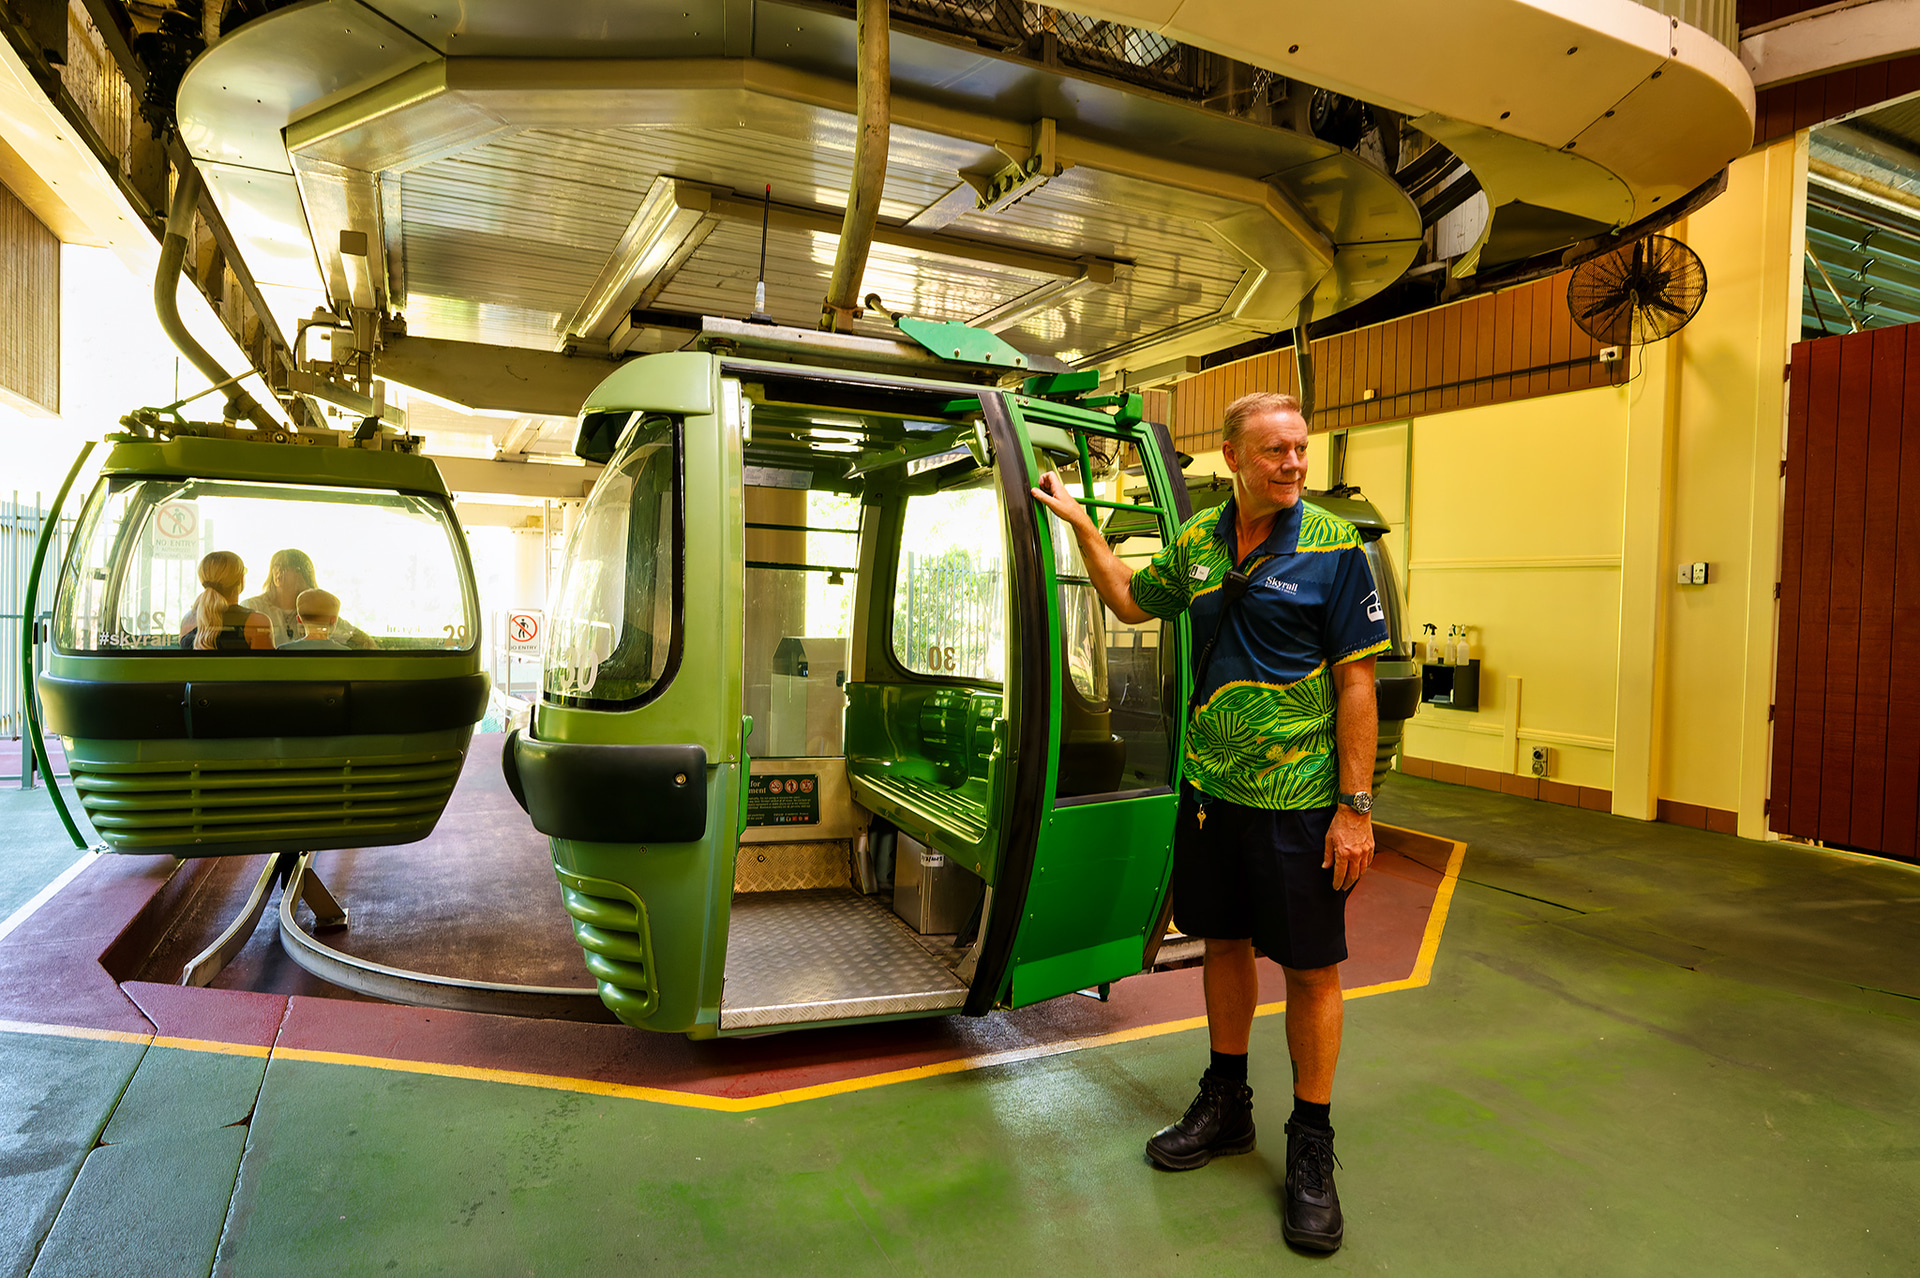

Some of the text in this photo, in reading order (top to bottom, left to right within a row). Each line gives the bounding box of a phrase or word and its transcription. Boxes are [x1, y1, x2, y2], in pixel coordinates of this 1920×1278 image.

[1267, 576, 1298, 592] Skyrail
[99, 630, 171, 650] #skyrail
[443, 624, 467, 647] 29
[560, 648, 598, 692] 30
